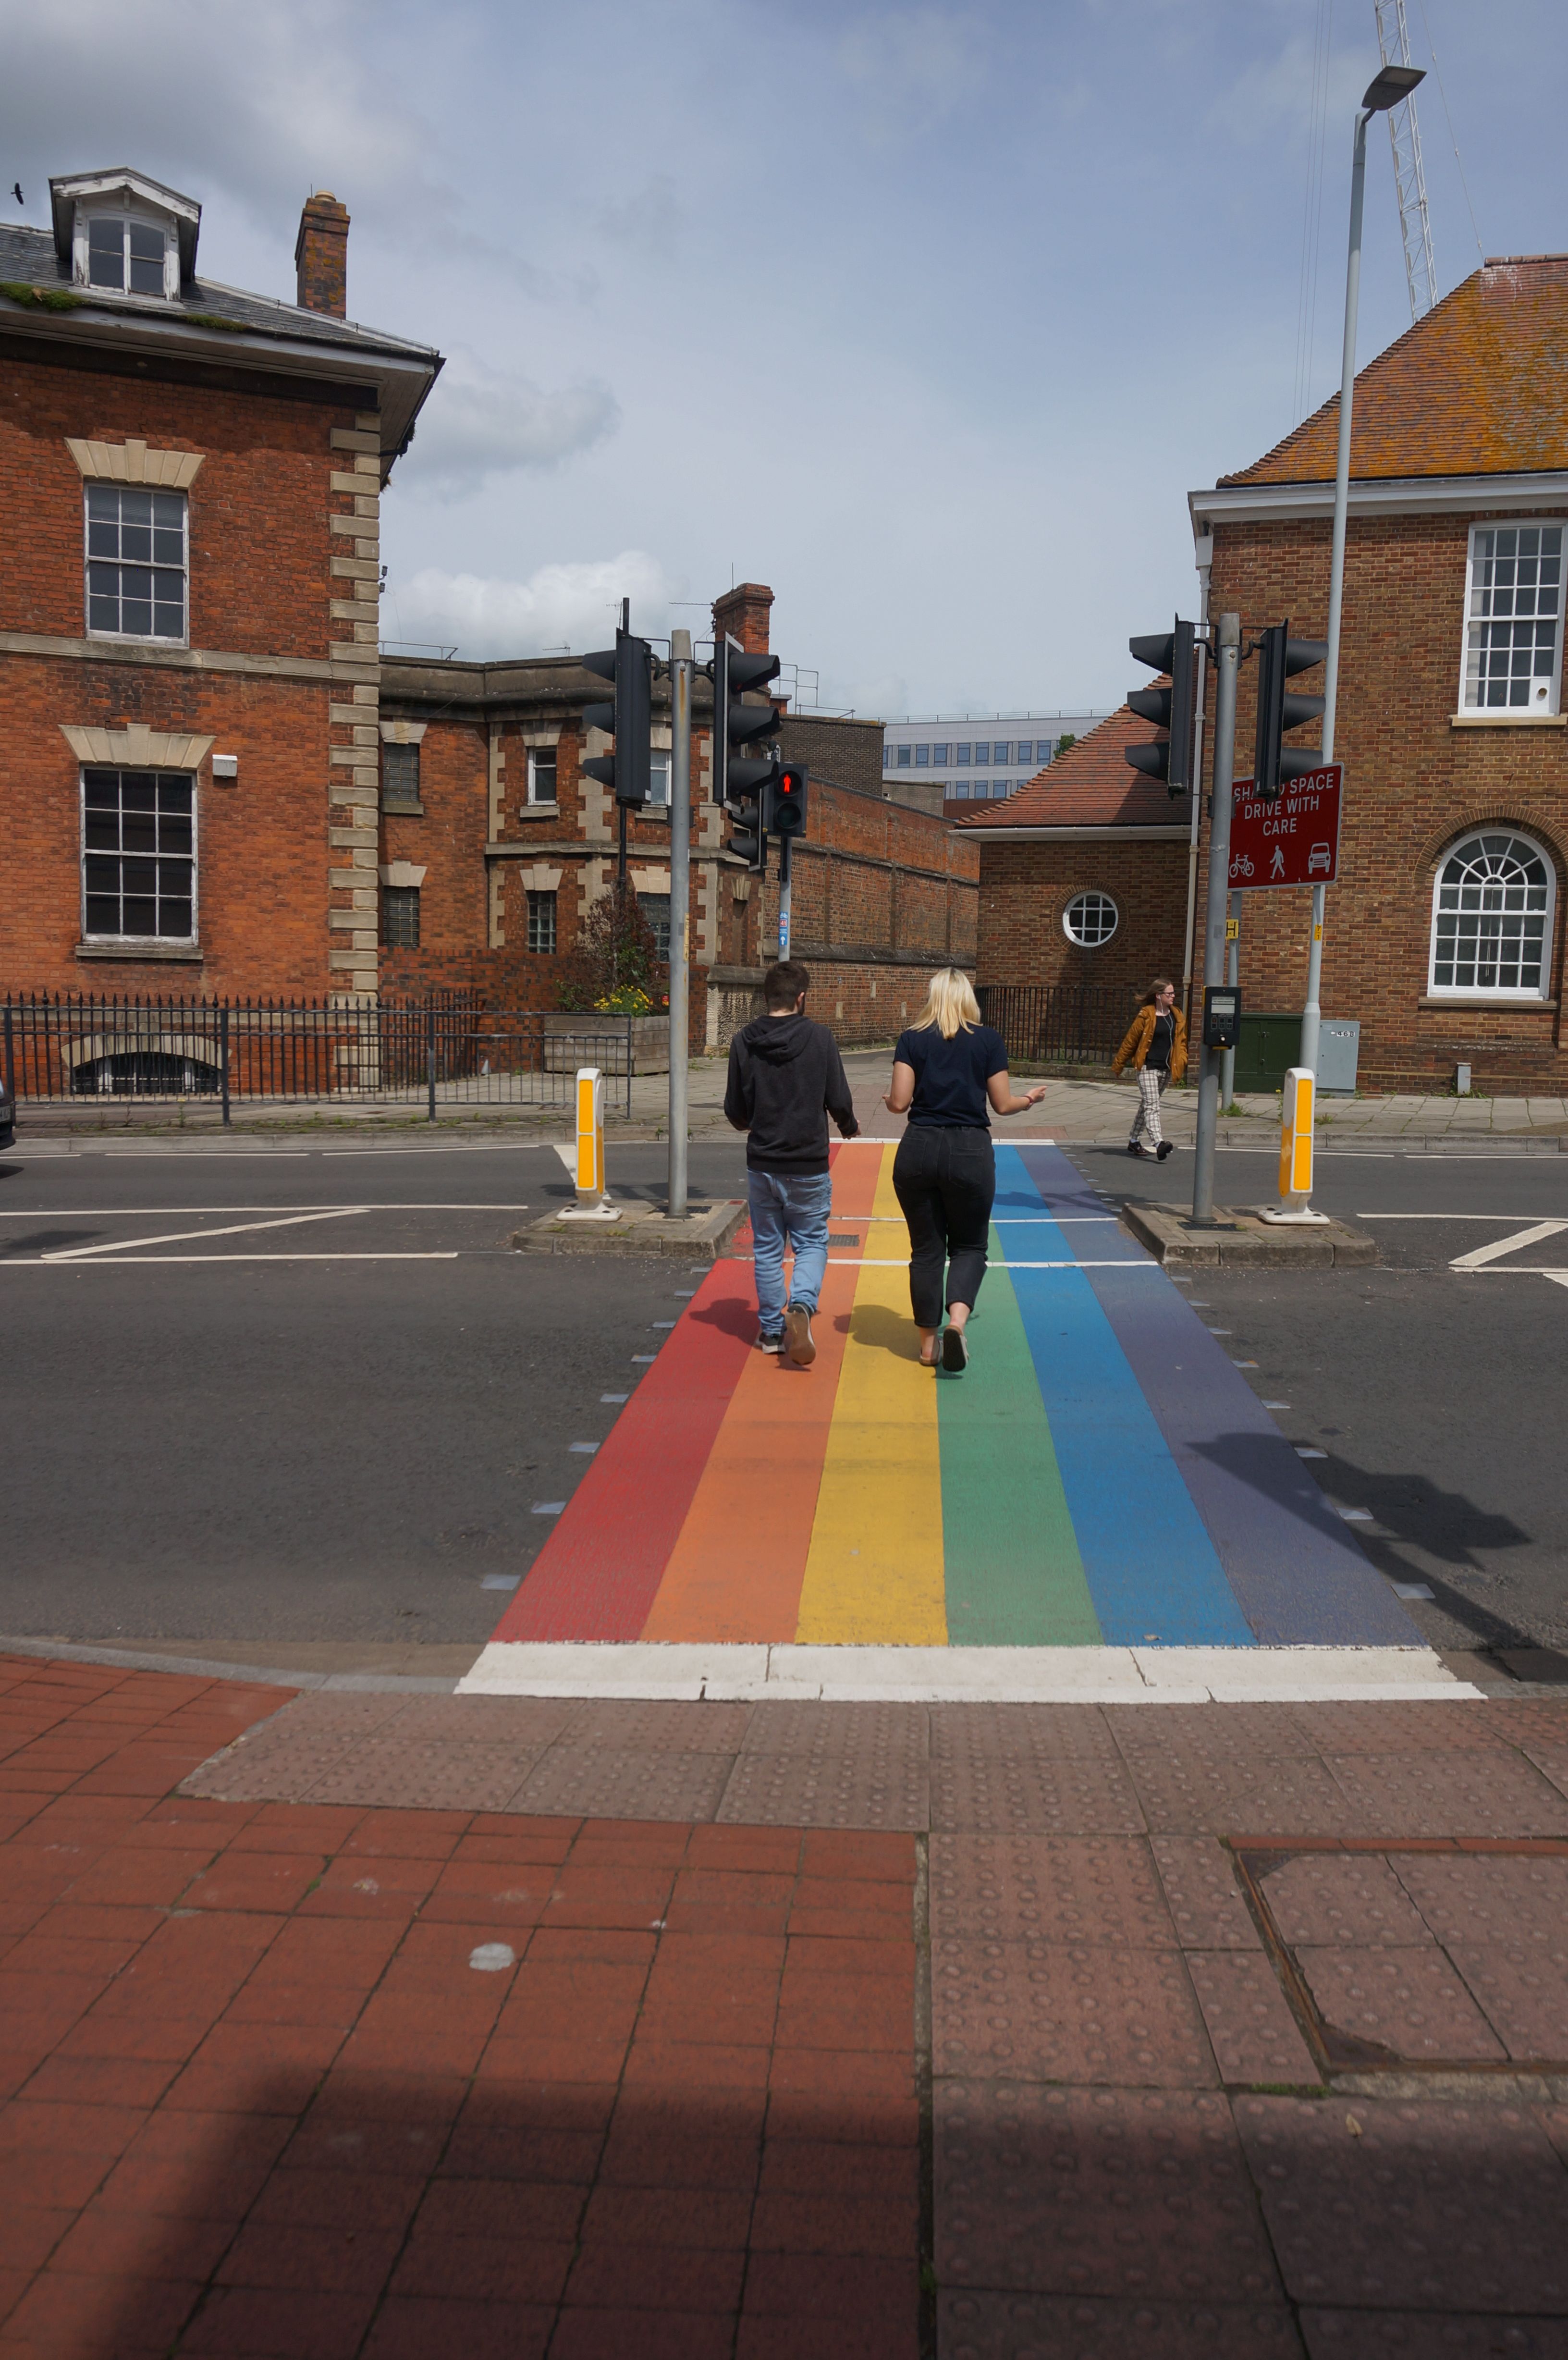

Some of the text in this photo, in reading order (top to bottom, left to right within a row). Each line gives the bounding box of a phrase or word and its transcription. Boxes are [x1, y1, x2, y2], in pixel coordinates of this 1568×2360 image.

[1289, 773, 1334, 794] SPACE
[1244, 795, 1320, 820] DRIVE WITH
[1262, 818, 1297, 836] CARE
[1226, 922, 1236, 937] H
